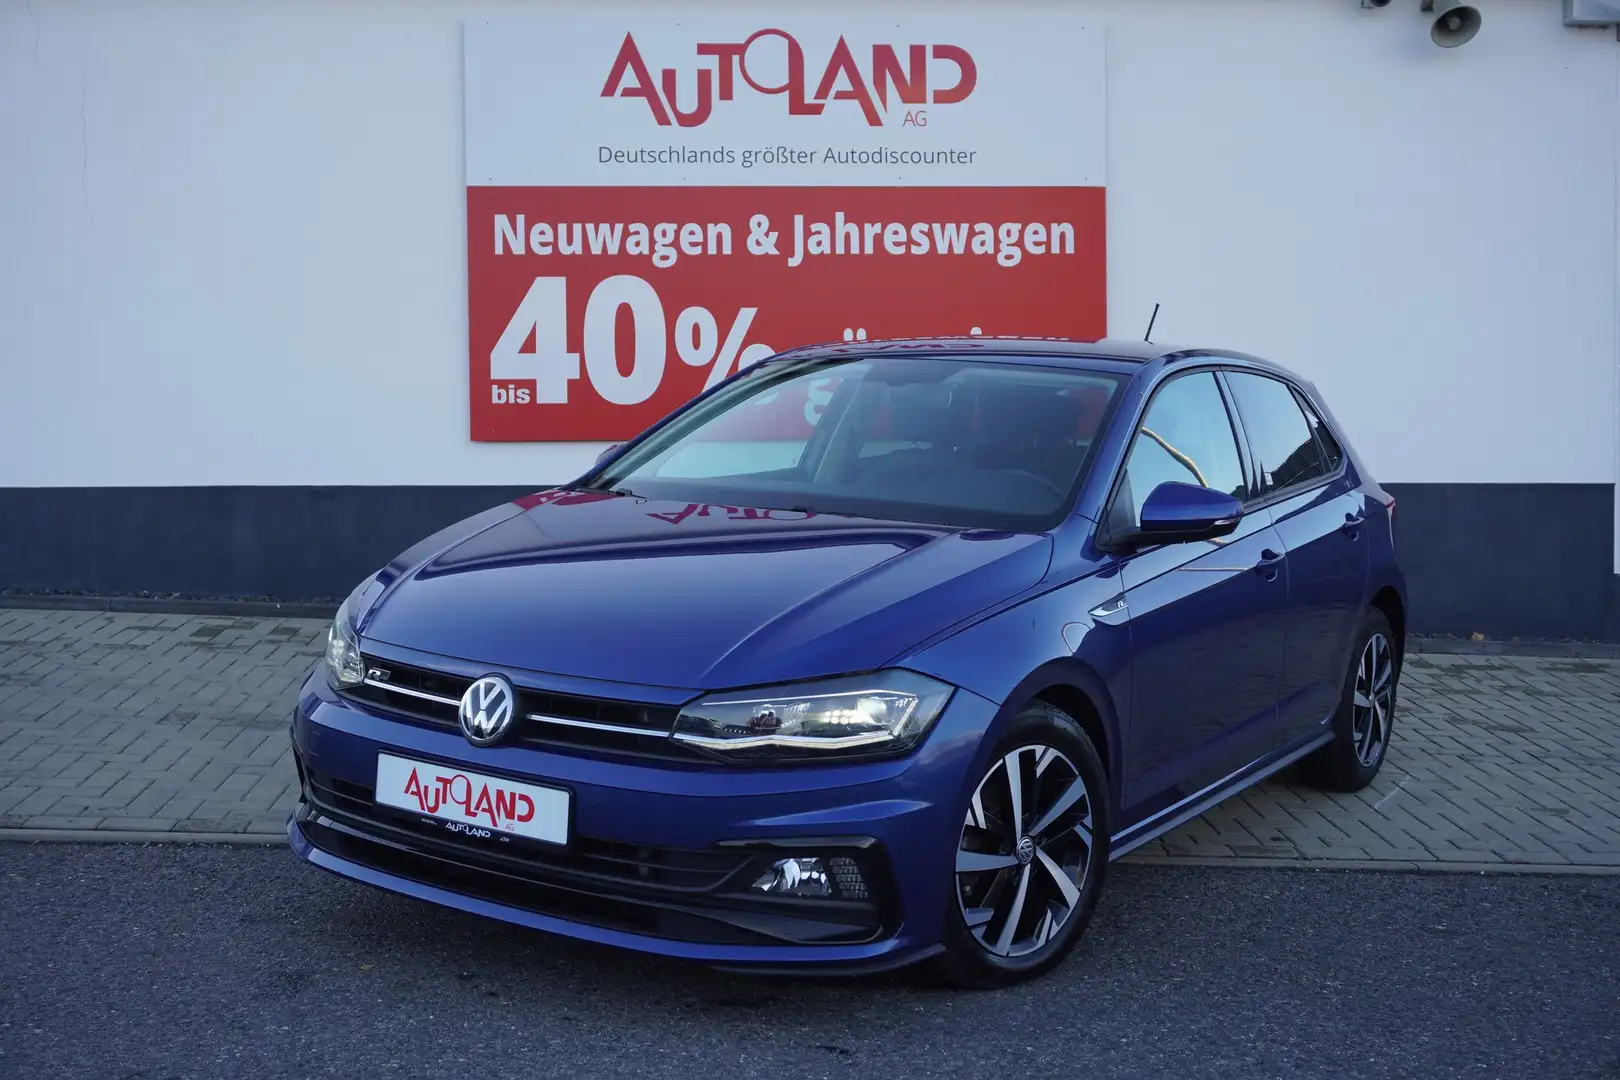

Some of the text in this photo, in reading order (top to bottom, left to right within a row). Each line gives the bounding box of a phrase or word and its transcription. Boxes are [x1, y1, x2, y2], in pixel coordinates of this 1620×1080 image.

[600, 28, 978, 128] AUTOLAND AG
[598, 145, 977, 168] Deutschlands größter Autodiscounter
[493, 211, 1075, 268] Neuwagen & Jahreswagen
[491, 384, 531, 404] bis
[404, 767, 535, 827] AUTOLAND
[445, 822, 491, 838] AUTOLAND
